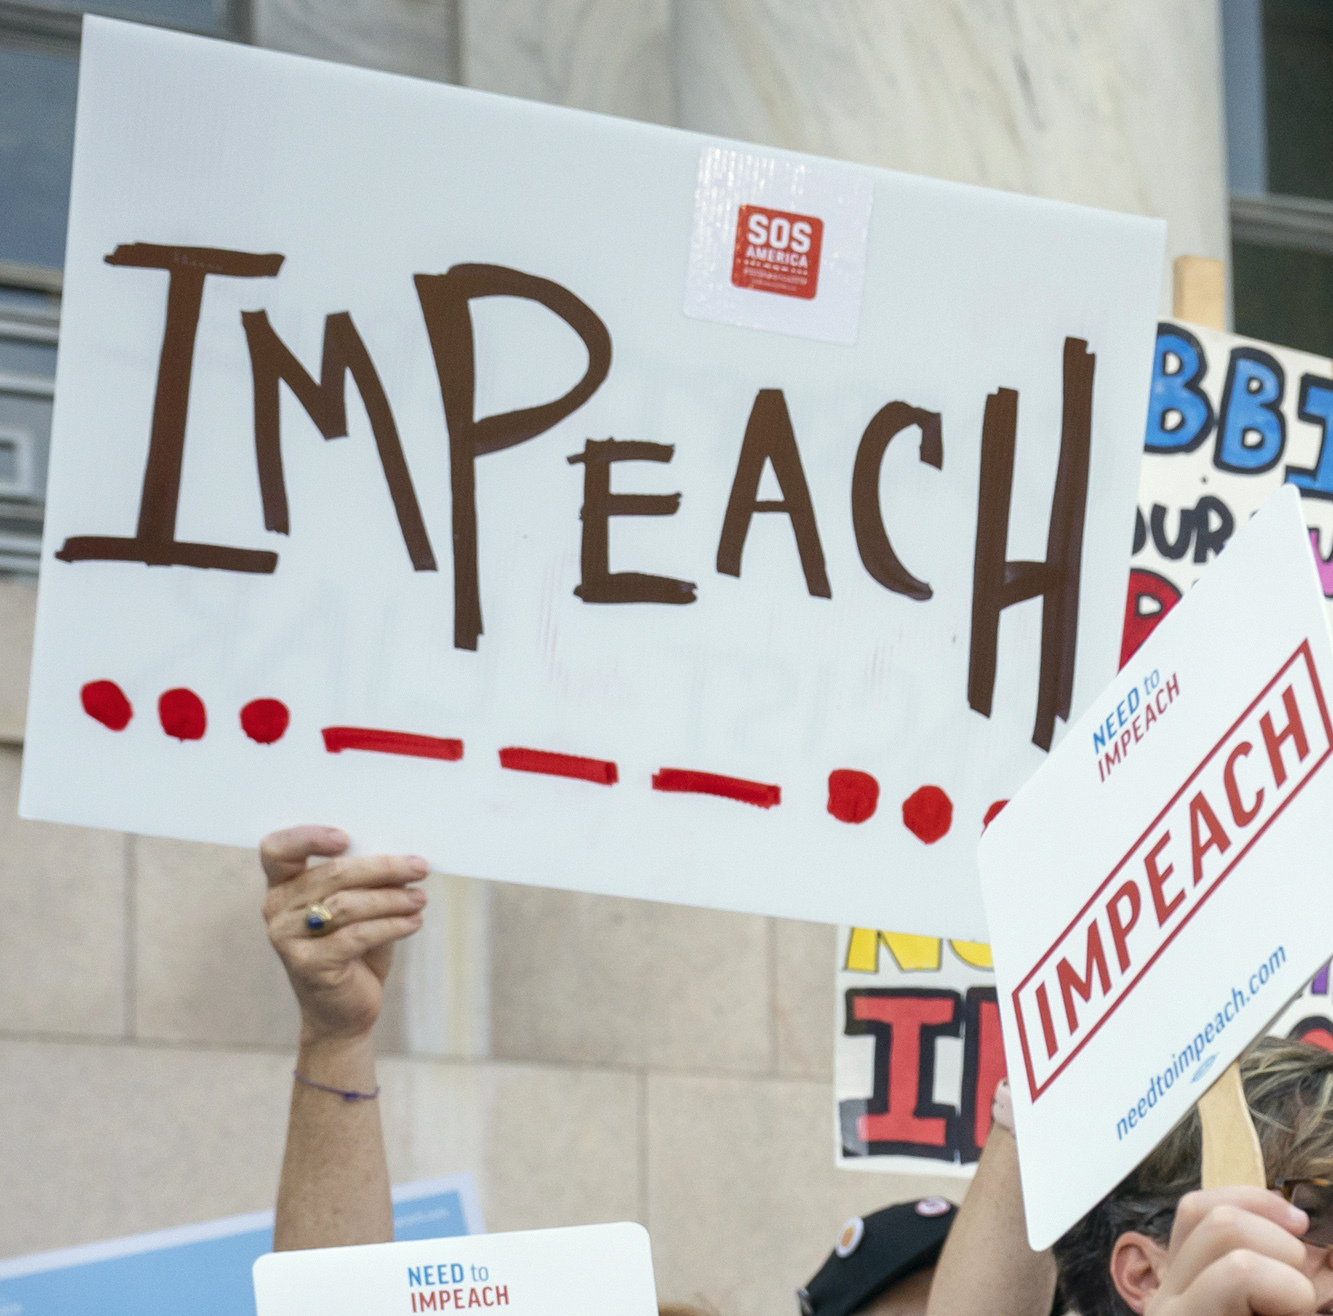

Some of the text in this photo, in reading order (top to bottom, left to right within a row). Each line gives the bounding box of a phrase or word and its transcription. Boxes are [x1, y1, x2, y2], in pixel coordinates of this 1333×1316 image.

[745, 244, 809, 269] AMERICA
[747, 213, 813, 253] SOS
[1092, 686, 1141, 756] NEED
[1143, 668, 1161, 697] to
[1098, 671, 1181, 783] IMPEACH
[1032, 684, 1311, 1062] IMPEACH
[1116, 945, 1287, 1142] needtoimpeach.com
[407, 1261, 490, 1289] NEED to
[409, 1285, 511, 1314] IMPEACH
